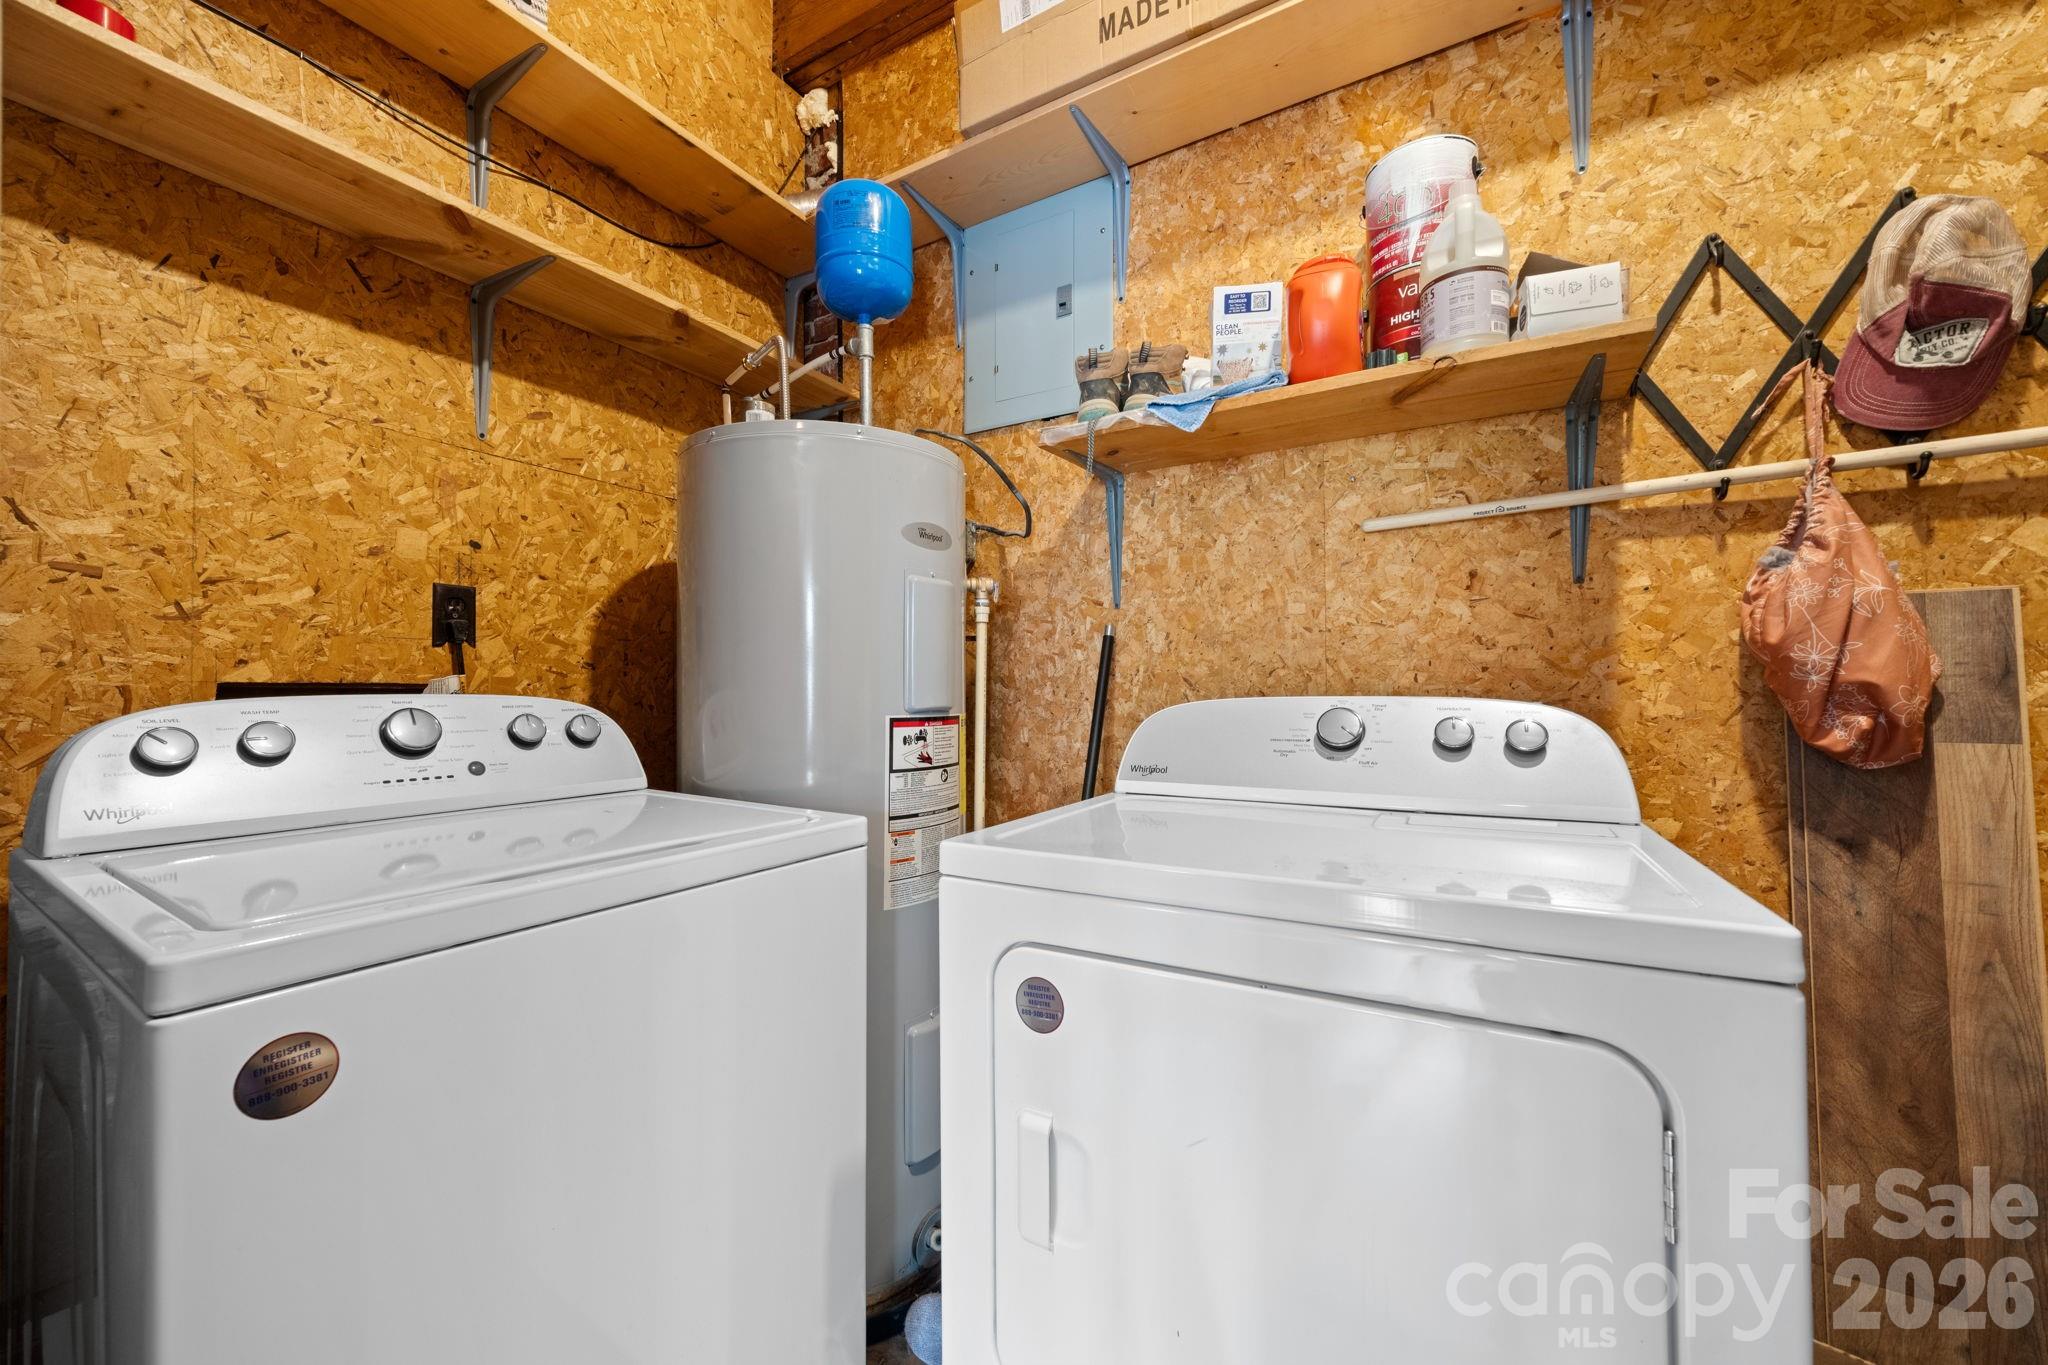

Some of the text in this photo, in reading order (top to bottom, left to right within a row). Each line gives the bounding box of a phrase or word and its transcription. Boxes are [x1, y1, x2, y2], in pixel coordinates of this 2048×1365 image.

[1099, 0, 1170, 44] MADE
[1215, 323, 1239, 331] CLEAN
[1130, 764, 1168, 777] Whirlpool
[252, 1047, 322, 1079] ENREGISTRER
[262, 1040, 312, 1064] REGISTER
[264, 1061, 314, 1086] REGISTRE
[247, 1071, 329, 1108] 888-900-3381
